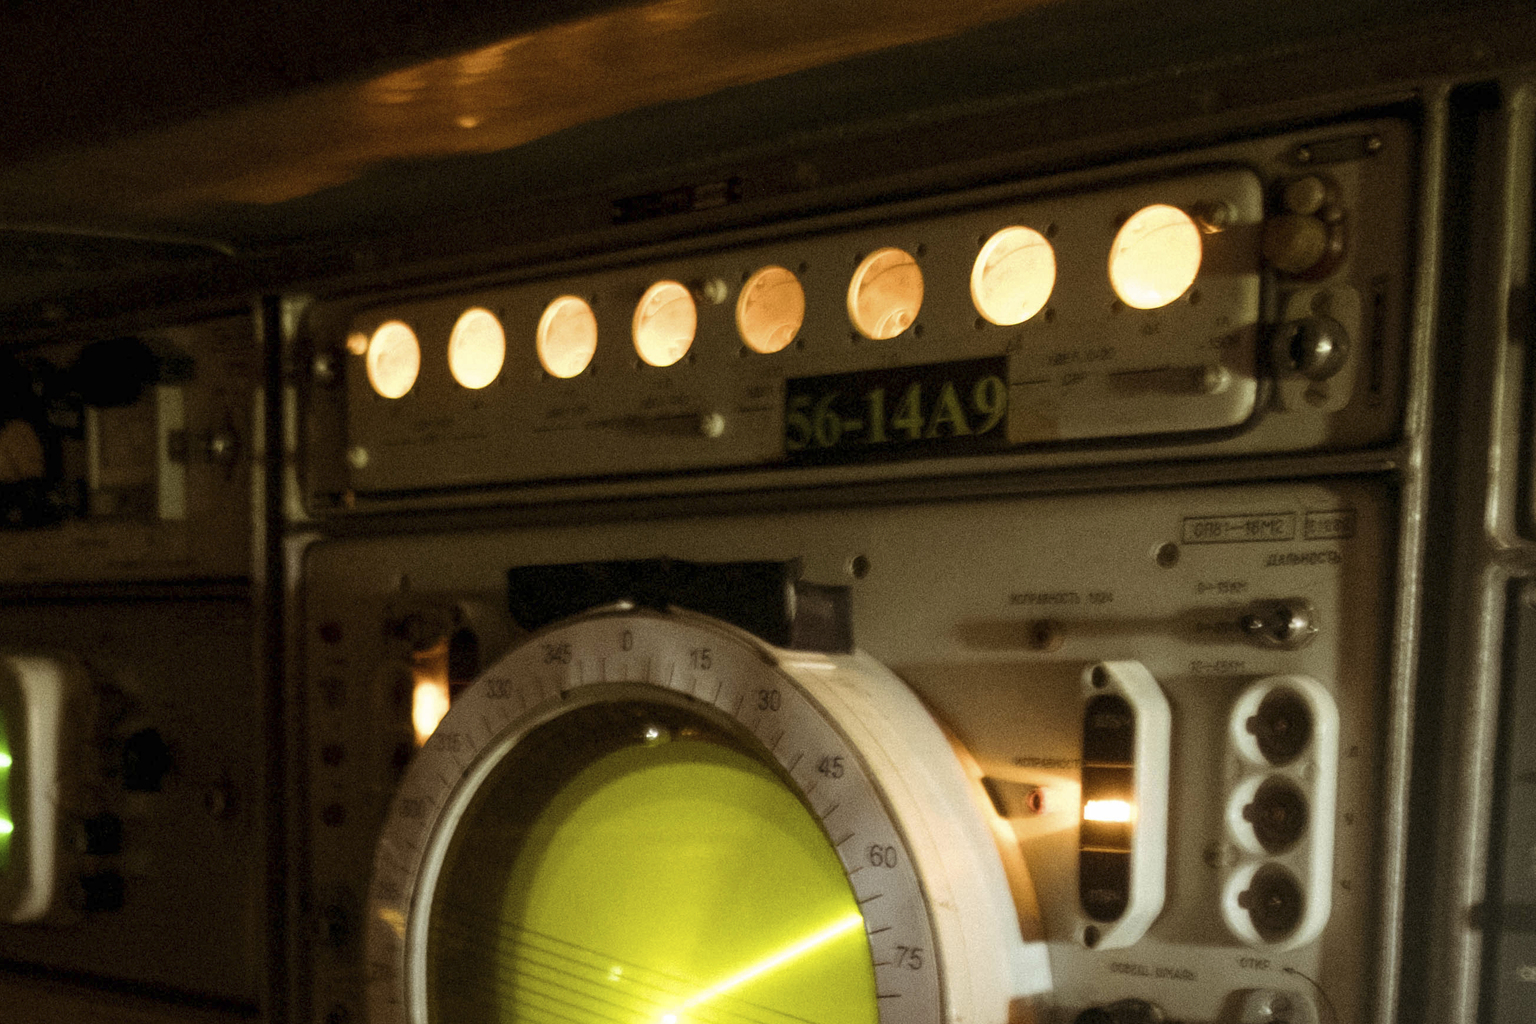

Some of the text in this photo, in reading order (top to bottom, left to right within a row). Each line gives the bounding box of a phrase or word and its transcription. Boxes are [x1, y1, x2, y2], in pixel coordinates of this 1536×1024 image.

[621, 629, 634, 653] 0
[689, 648, 713, 671] 15
[758, 688, 782, 712] 30
[817, 755, 847, 780] 45
[868, 842, 899, 870] 60
[896, 944, 924, 971] 75
